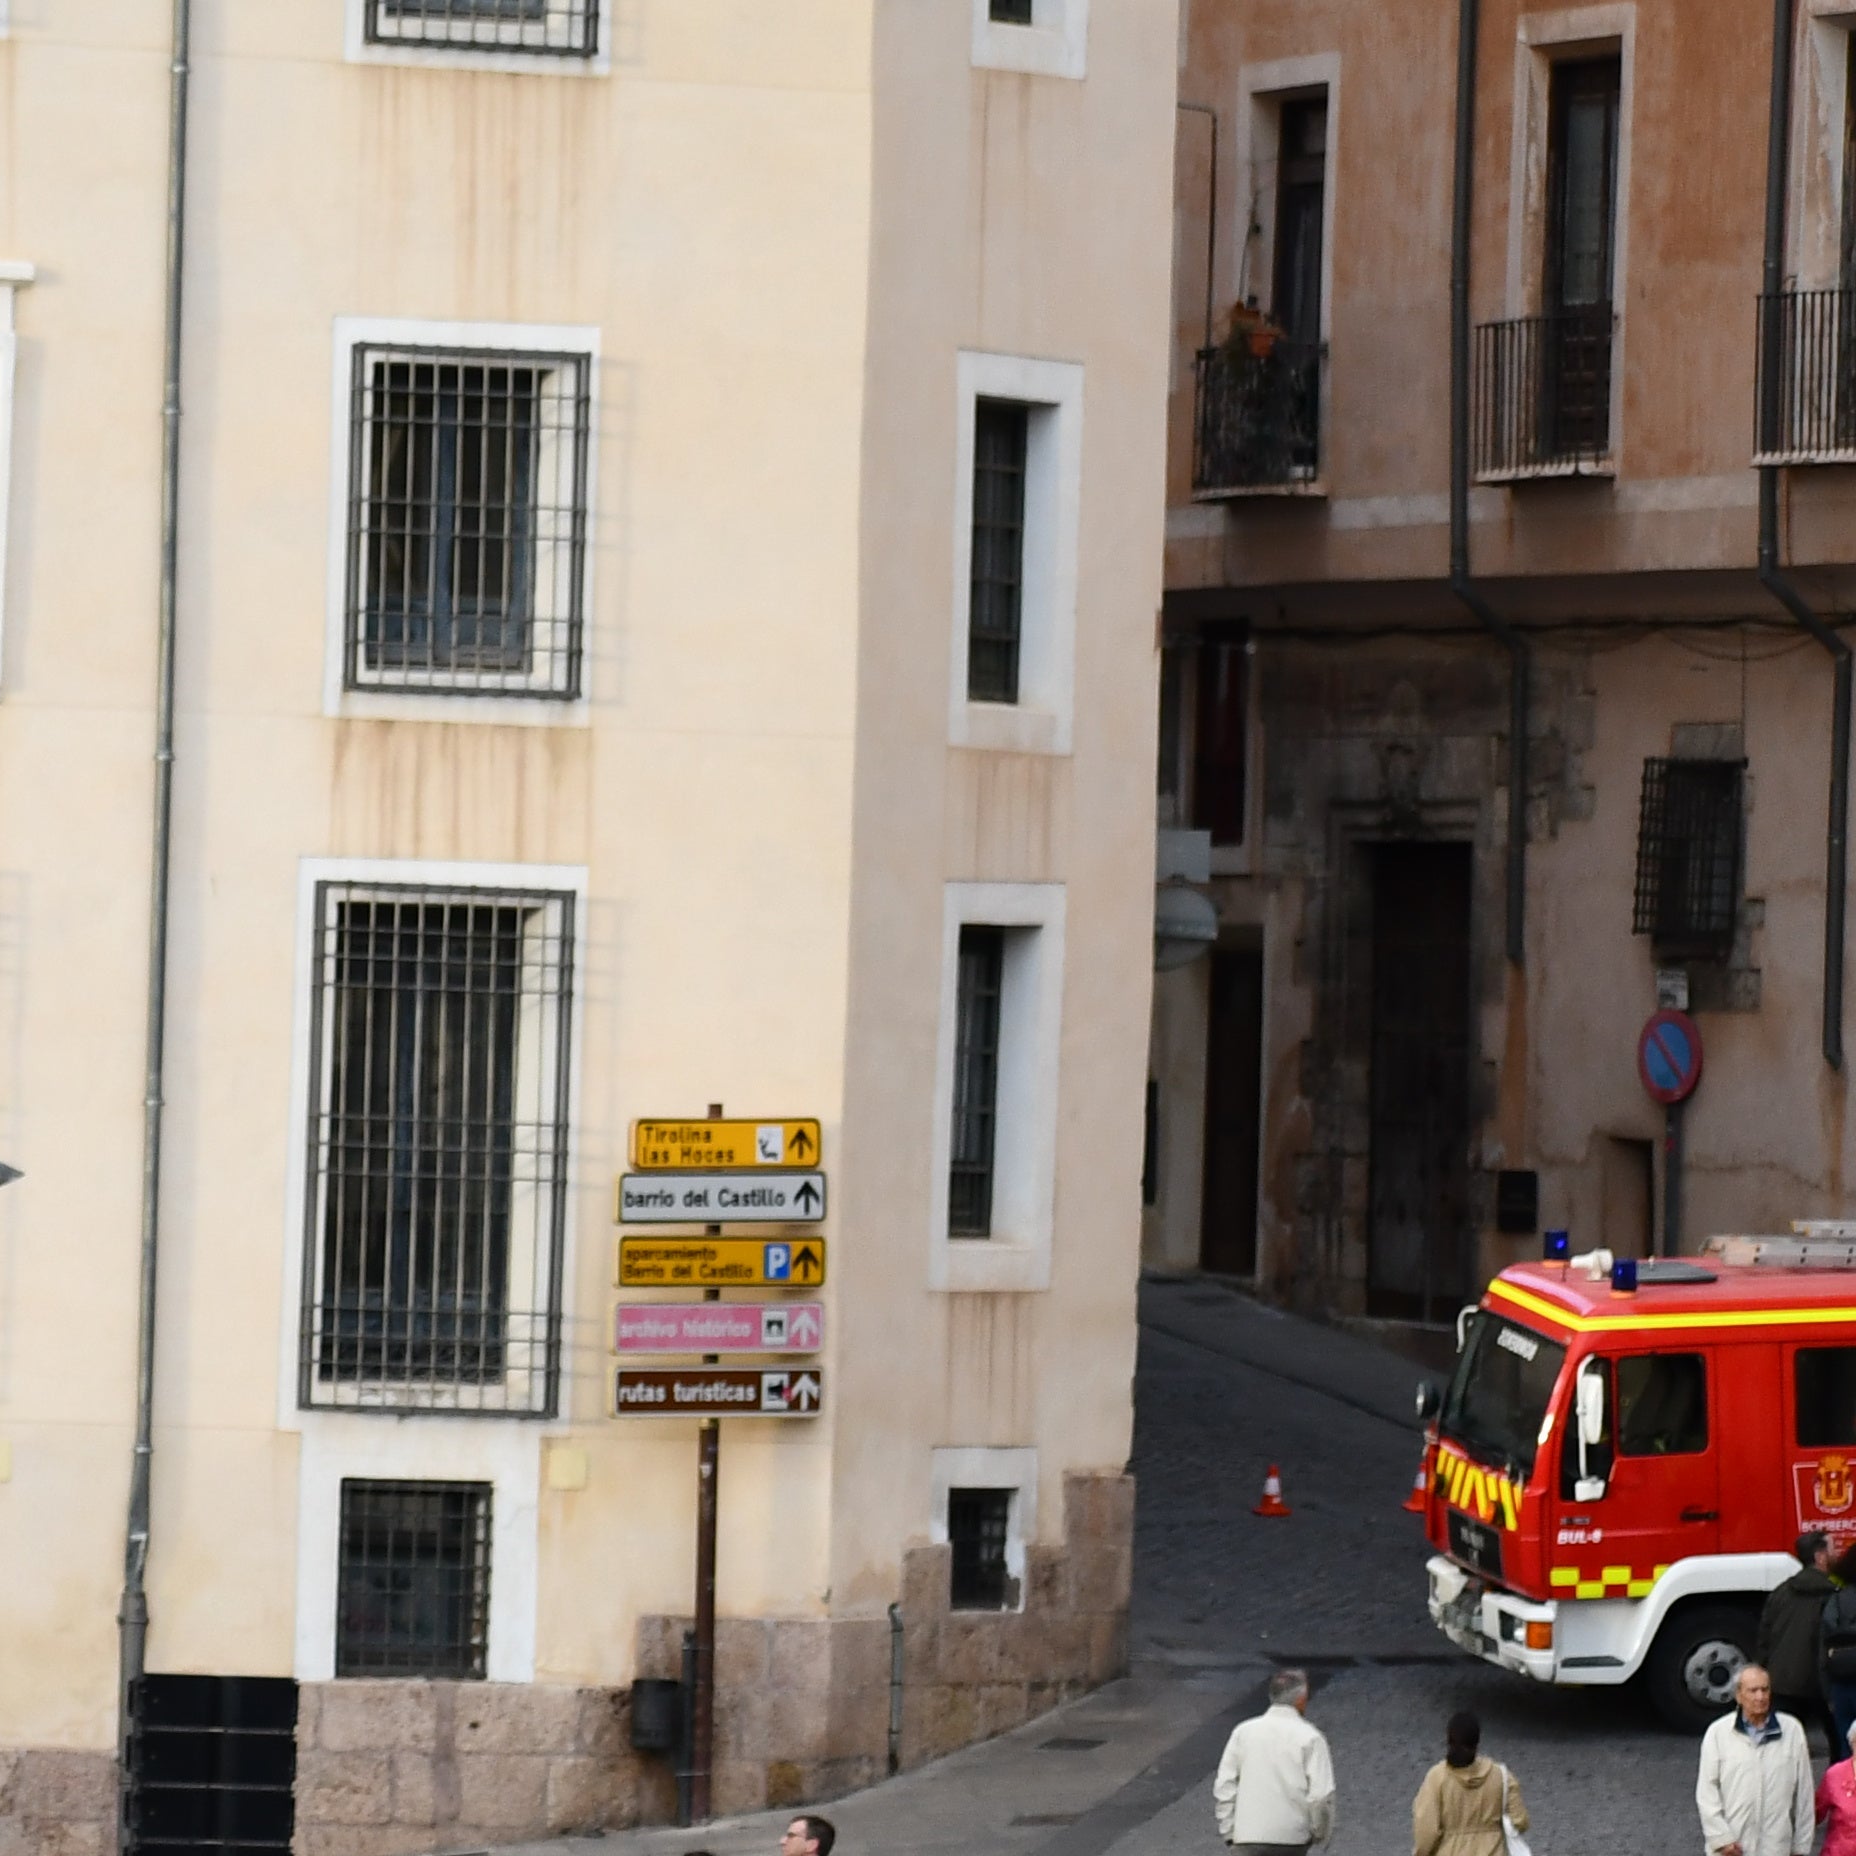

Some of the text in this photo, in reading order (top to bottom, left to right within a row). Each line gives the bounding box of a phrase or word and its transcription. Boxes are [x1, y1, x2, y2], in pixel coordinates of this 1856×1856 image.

[644, 1126, 713, 1144] Tirolina
[624, 1187, 787, 1208] barrio del Castillo
[671, 1264, 692, 1279] del
[699, 1263, 754, 1280] Castillo
[618, 1382, 667, 1403] rutas
